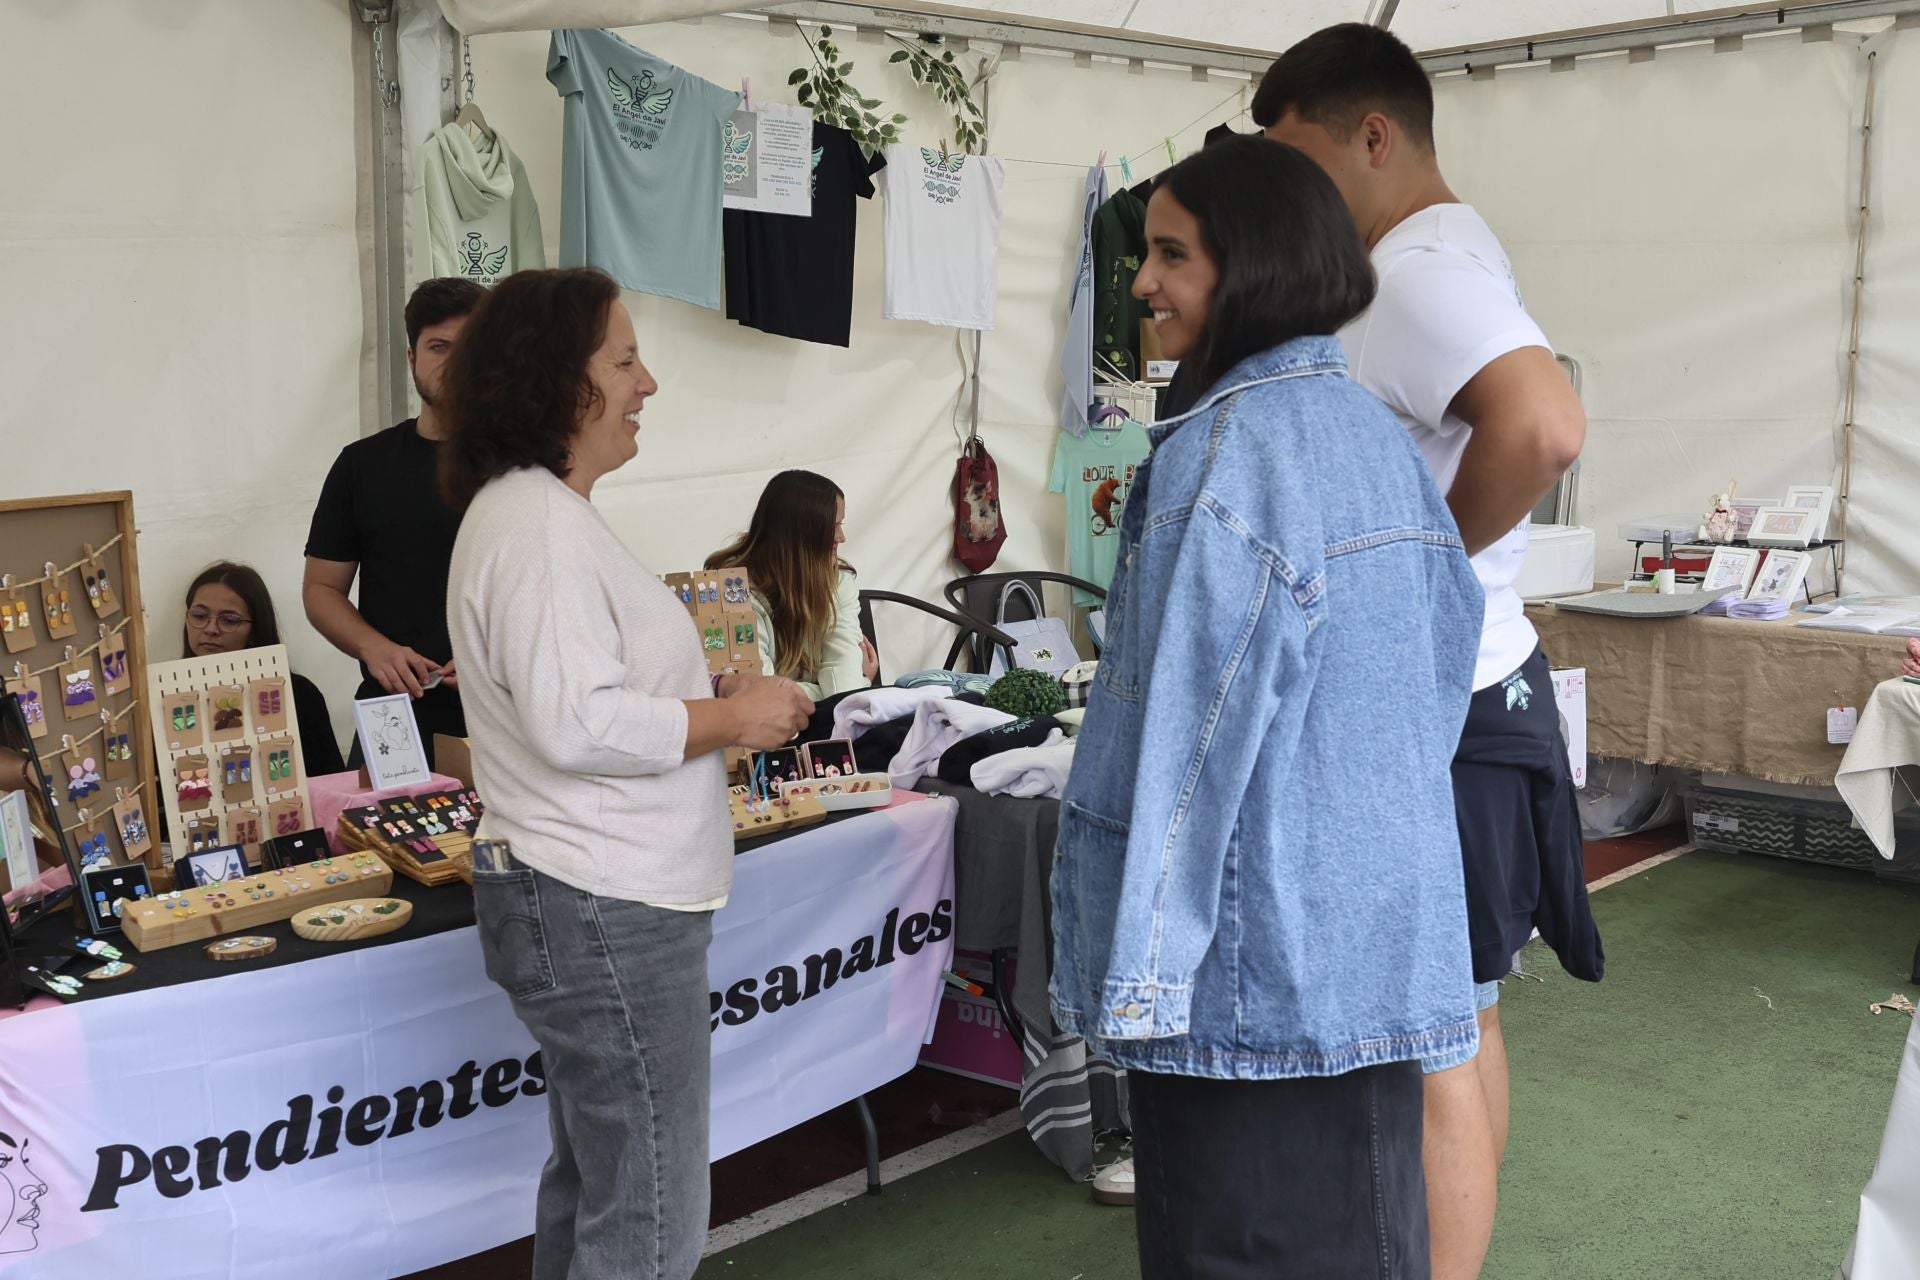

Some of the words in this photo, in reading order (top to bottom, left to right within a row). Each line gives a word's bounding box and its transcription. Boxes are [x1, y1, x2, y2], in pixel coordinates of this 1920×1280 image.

[613, 103, 619, 111] El
[622, 107, 641, 120] Angel
[654, 116, 666, 125] Javi
[930, 169, 944, 178] Angel
[1083, 465, 1115, 482] LOVE
[80, 1050, 547, 1212] Pendientes
